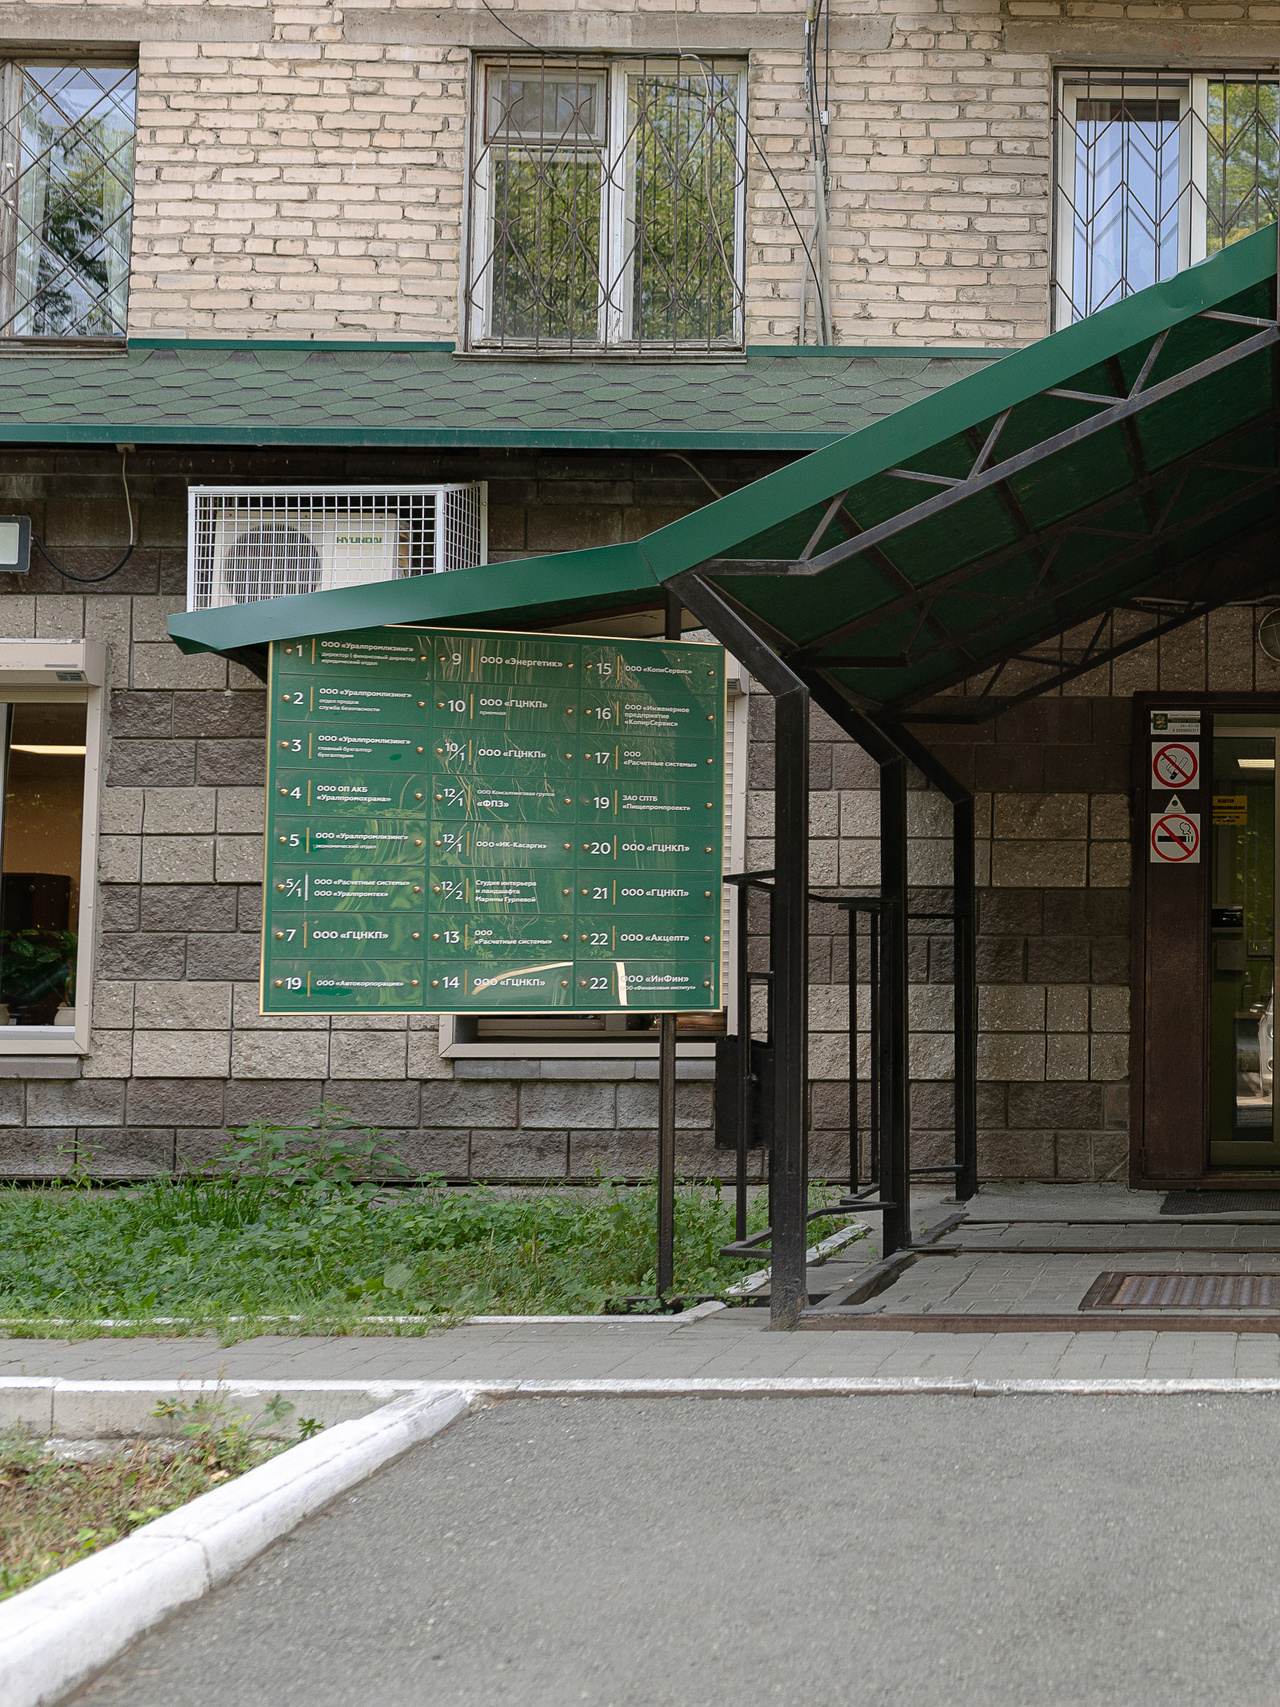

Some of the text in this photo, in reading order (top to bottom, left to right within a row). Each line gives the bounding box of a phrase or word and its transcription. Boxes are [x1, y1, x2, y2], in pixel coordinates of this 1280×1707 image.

[296, 645, 303, 657] 1
[341, 643, 414, 652] «Уралпромлизинг»
[451, 653, 462, 665] 9
[480, 656, 563, 668] ООО «Энергетик»
[596, 663, 612, 675] 15
[293, 692, 304, 705] 2
[339, 689, 412, 698] «Уралпромлизинг»
[448, 699, 466, 712] 10
[479, 698, 548, 709] ООО «ГЦНКП»
[595, 707, 612, 720] 16
[291, 739, 302, 752] 3
[338, 736, 411, 745] «Уралпромлизинг»
[478, 748, 547, 759] ООО «ГЦНКП»
[594, 752, 611, 764] 17
[290, 787, 302, 799] 4
[316, 794, 392, 803] «Уралпромохрана»
[593, 796, 610, 809] 19
[622, 803, 691, 812] «Пищепромпроект»
[289, 833, 300, 847] 5
[335, 833, 409, 841] «Уралпромлизинг»
[590, 842, 611, 855] 20
[621, 843, 690, 853] ООО «ГЦНКП»
[314, 878, 333, 886] ООО
[592, 887, 608, 900] 21
[621, 888, 690, 898] ООО «ГЦНКП»
[285, 929, 297, 942] 7
[312, 931, 389, 940] ООО «ГЦНКП»
[443, 931, 460, 944] 13
[590, 933, 609, 946] 22
[620, 933, 690, 943] ООО «Акцепт»
[285, 977, 302, 990] 19
[442, 976, 460, 989] 14
[473, 978, 546, 987] ООО «ГЦНКП»
[589, 977, 608, 990] 22
[620, 974, 690, 983] ООО «ИнФин»
